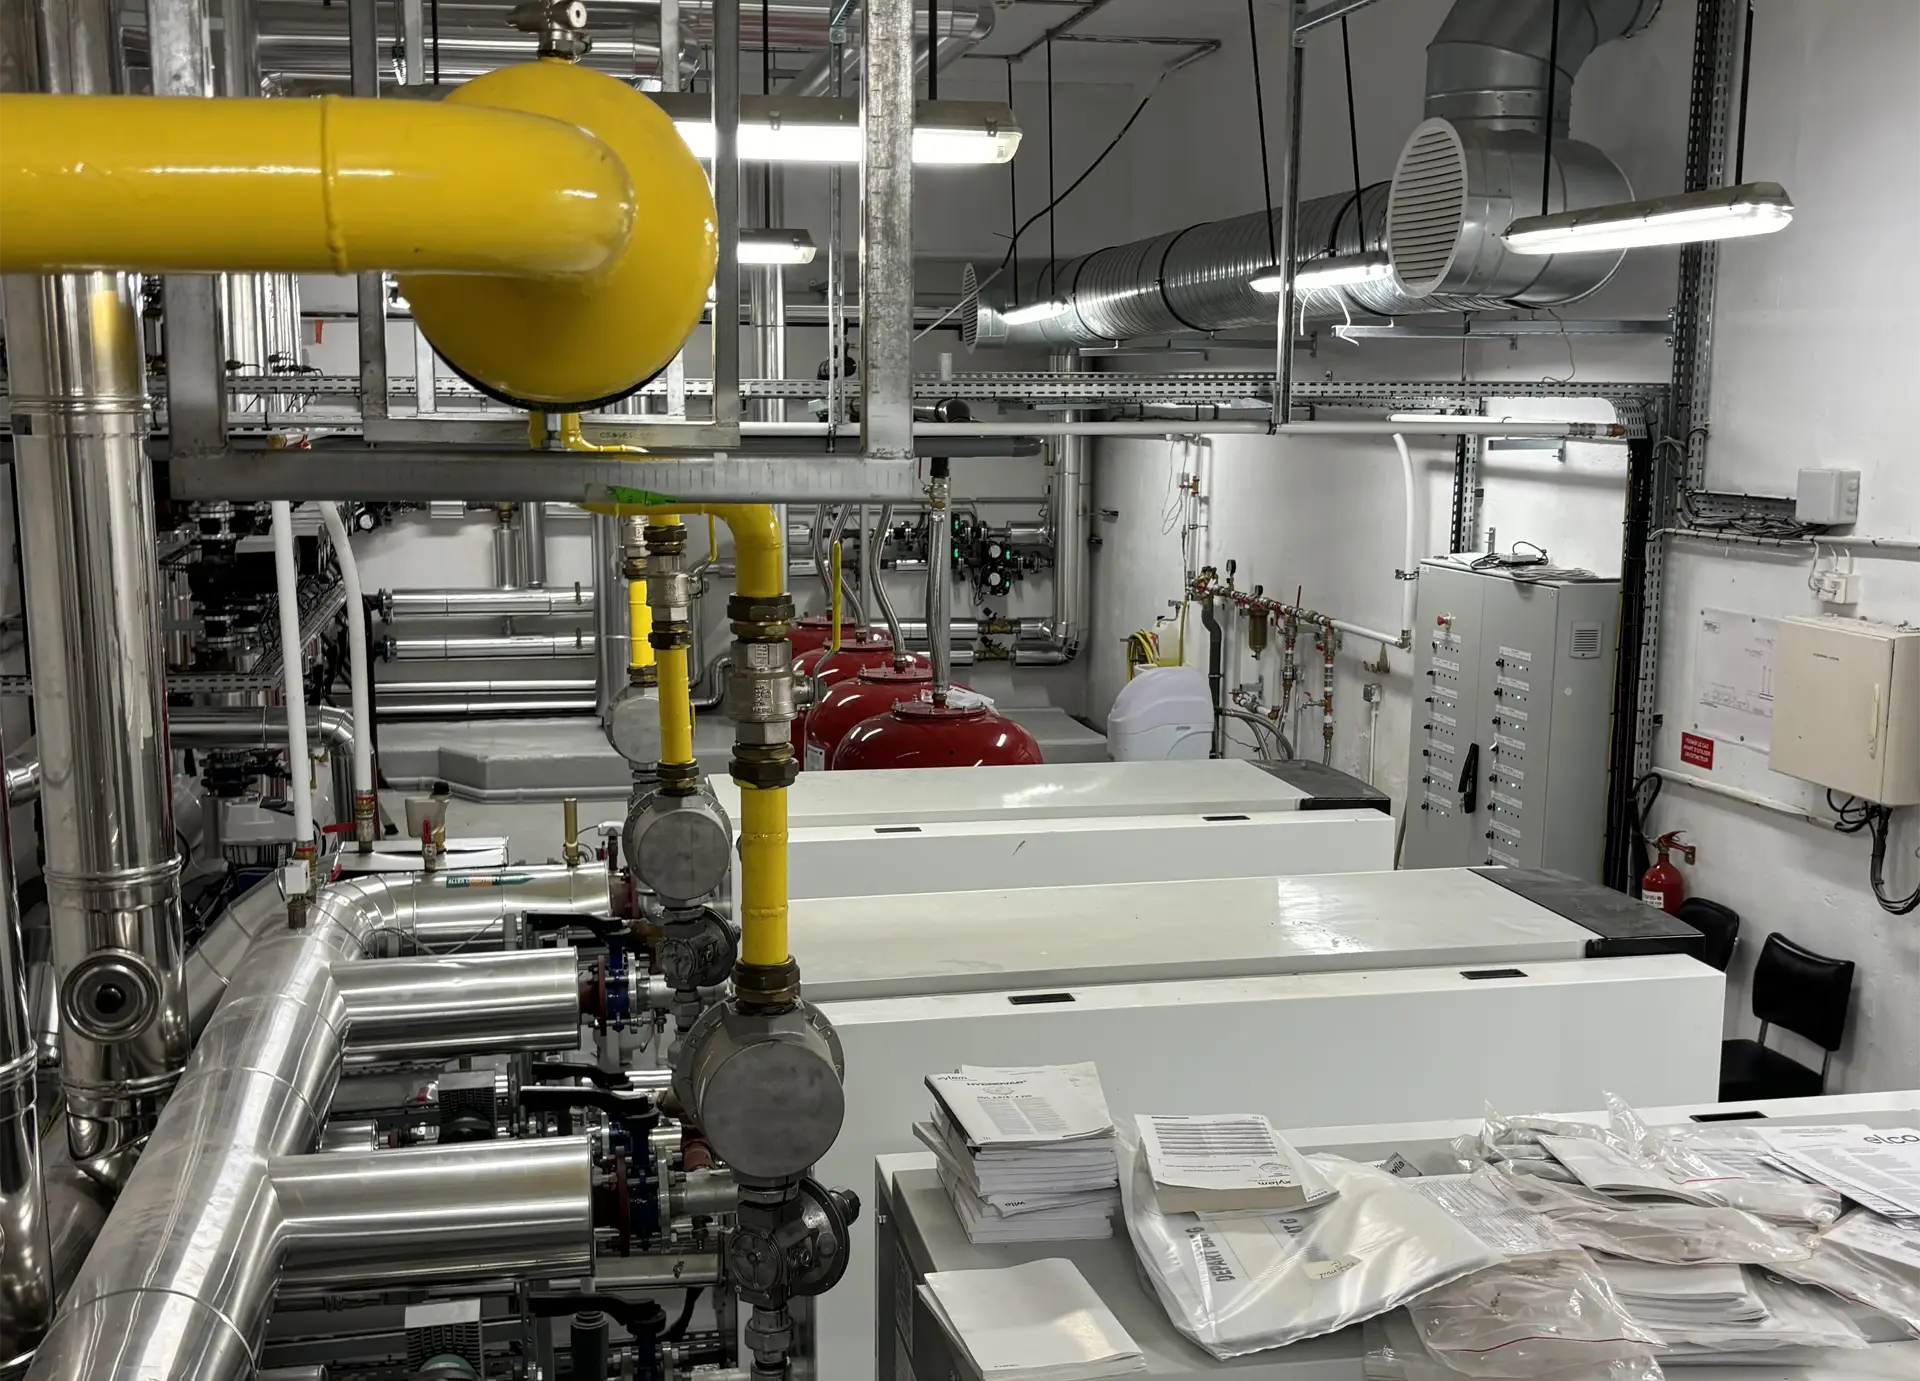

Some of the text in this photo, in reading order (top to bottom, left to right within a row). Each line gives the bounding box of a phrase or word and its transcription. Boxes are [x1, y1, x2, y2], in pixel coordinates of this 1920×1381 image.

[1863, 1134, 1920, 1144] elco
[1389, 1160, 1405, 1174] wilo
[1203, 1251, 1236, 1281] DEPART
